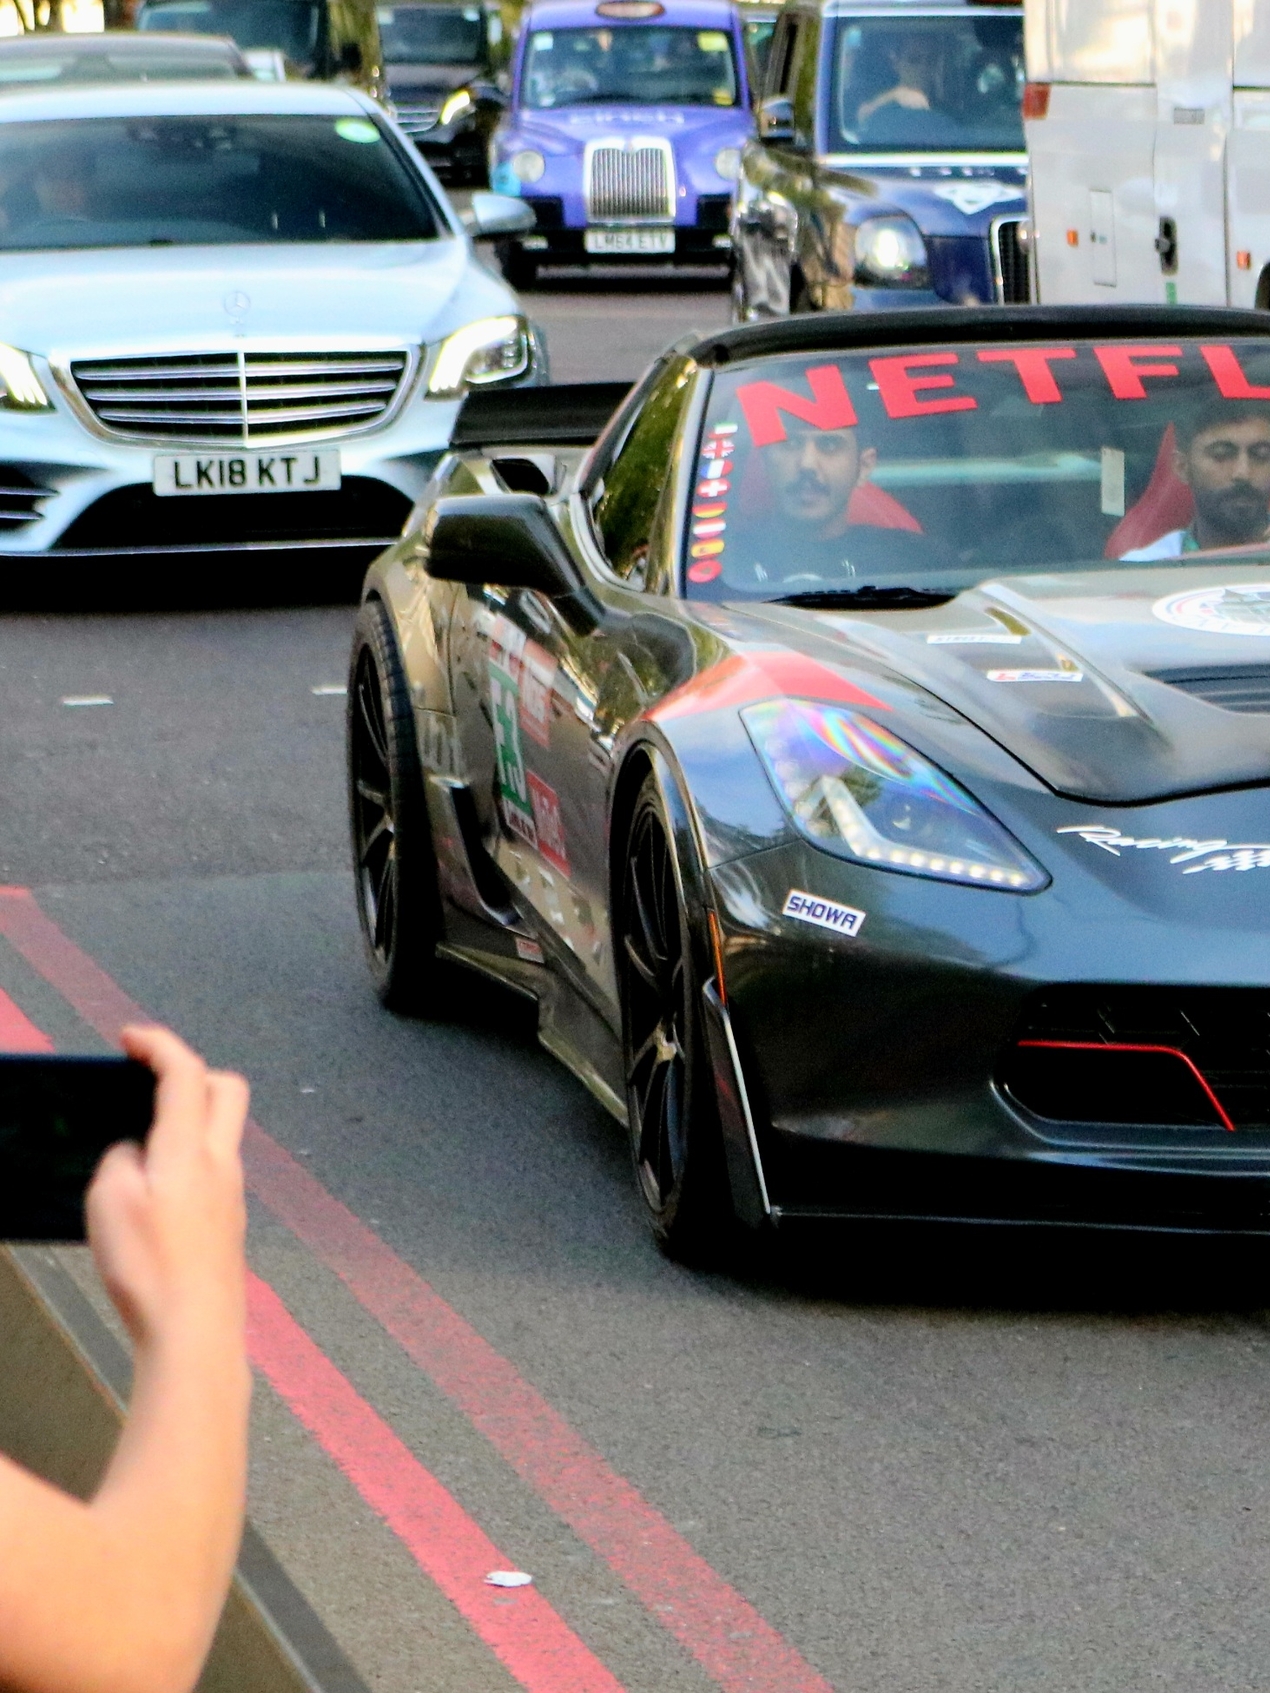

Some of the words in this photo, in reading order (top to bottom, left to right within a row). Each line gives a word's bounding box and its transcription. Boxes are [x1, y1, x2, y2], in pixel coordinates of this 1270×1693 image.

[174, 458, 247, 490] LK18
[257, 455, 321, 487] KTJ
[787, 895, 858, 930] SHOWA
